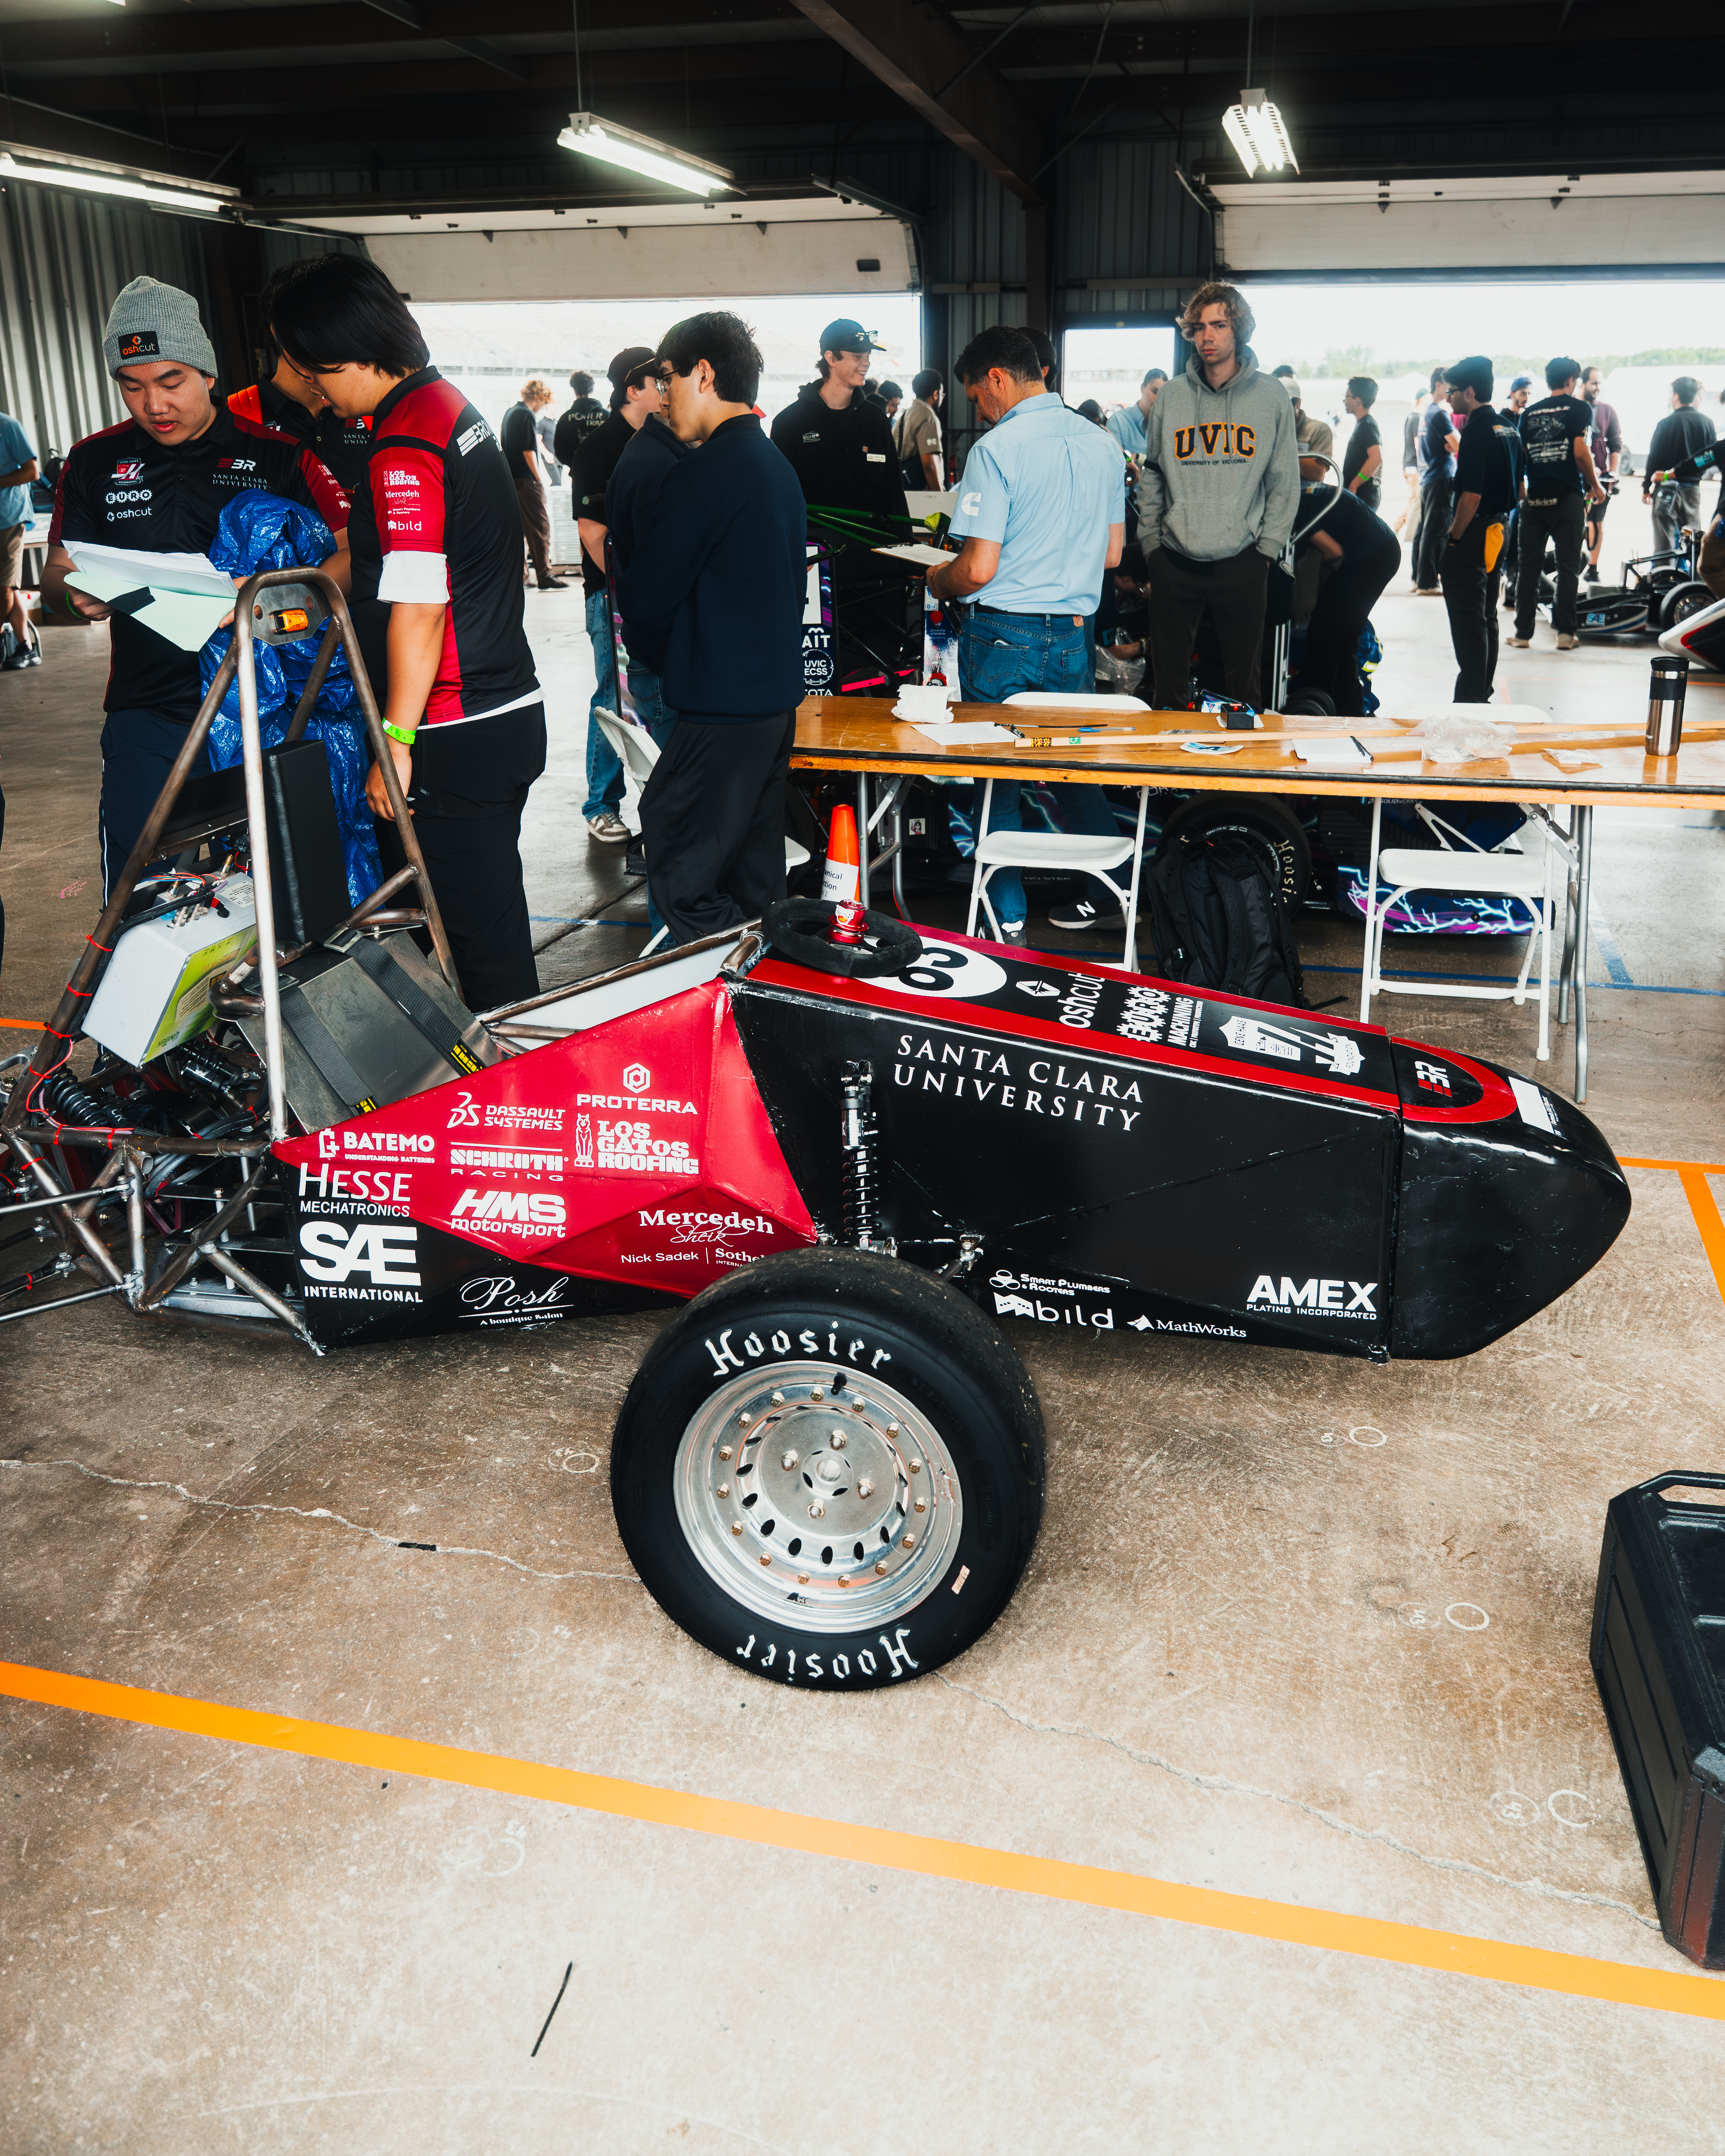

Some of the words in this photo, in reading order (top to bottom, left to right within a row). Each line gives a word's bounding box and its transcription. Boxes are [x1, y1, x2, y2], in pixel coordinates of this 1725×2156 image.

[123, 343, 155, 355] oshcut
[1175, 422, 1256, 460] UVIC
[213, 479, 267, 490] UNIVERSITY
[243, 476, 267, 484] CLARA
[106, 490, 151, 503] EURO
[386, 490, 420, 498] Mercedeh
[1528, 498, 1557, 506] adidas
[117, 507, 152, 519] oshcut
[398, 520, 422, 531] bild
[1273, 840, 1295, 902] Hoosi
[1057, 973, 1105, 1028] oshcut
[1122, 988, 1166, 1040] EURO
[1168, 997, 1194, 1046] MACHINING
[1236, 1020, 1246, 1033] HAAS
[1235, 1033, 1245, 1046] GENE
[1346, 1043, 1355, 1068] FOUNDATION
[897, 1035, 1011, 1077] SANTA
[1029, 1061, 1143, 1104] CLARA
[577, 1093, 698, 1115] PROTERRA
[894, 1063, 1142, 1132] UNIVERSITY
[486, 1105, 566, 1120] DASSAULT
[484, 1116, 563, 1131] SYSTEMES
[597, 1120, 650, 1139] LOS
[344, 1131, 435, 1152] BATEMO
[597, 1136, 690, 1158] GATOS
[344, 1153, 399, 1162] UNDERSTANDING
[450, 1149, 563, 1171] SCHROTH
[598, 1152, 699, 1174] ROOFING
[299, 1162, 412, 1202] HESSE
[451, 1168, 563, 1182] RACING
[300, 1200, 410, 1217] MECHATRONICS
[450, 1188, 566, 1224] HMS
[450, 1218, 566, 1239] motorsport
[638, 1209, 774, 1234] Mercedeh
[670, 1220, 749, 1247] Sheik
[299, 1221, 421, 1286] SAE
[621, 1254, 652, 1263] Nick
[655, 1251, 699, 1262] Sadek
[715, 1247, 765, 1263] Sothe
[459, 1276, 569, 1310] Posh
[1020, 1273, 1056, 1286] SMART
[1058, 1279, 1110, 1294] PLUMBERS
[1029, 1282, 1075, 1296] ROOTERS
[1246, 1274, 1378, 1312] AMEX
[304, 1286, 423, 1303] INTERNATIONAL
[489, 1316, 533, 1325] boutique
[1036, 1300, 1114, 1329] bild
[1246, 1304, 1291, 1314] PLATING
[1296, 1307, 1377, 1321] INCORPORATED
[1156, 1319, 1247, 1337] MathWorks
[705, 1319, 892, 1377] Hoosier
[735, 1628, 920, 1682] Hoosier
